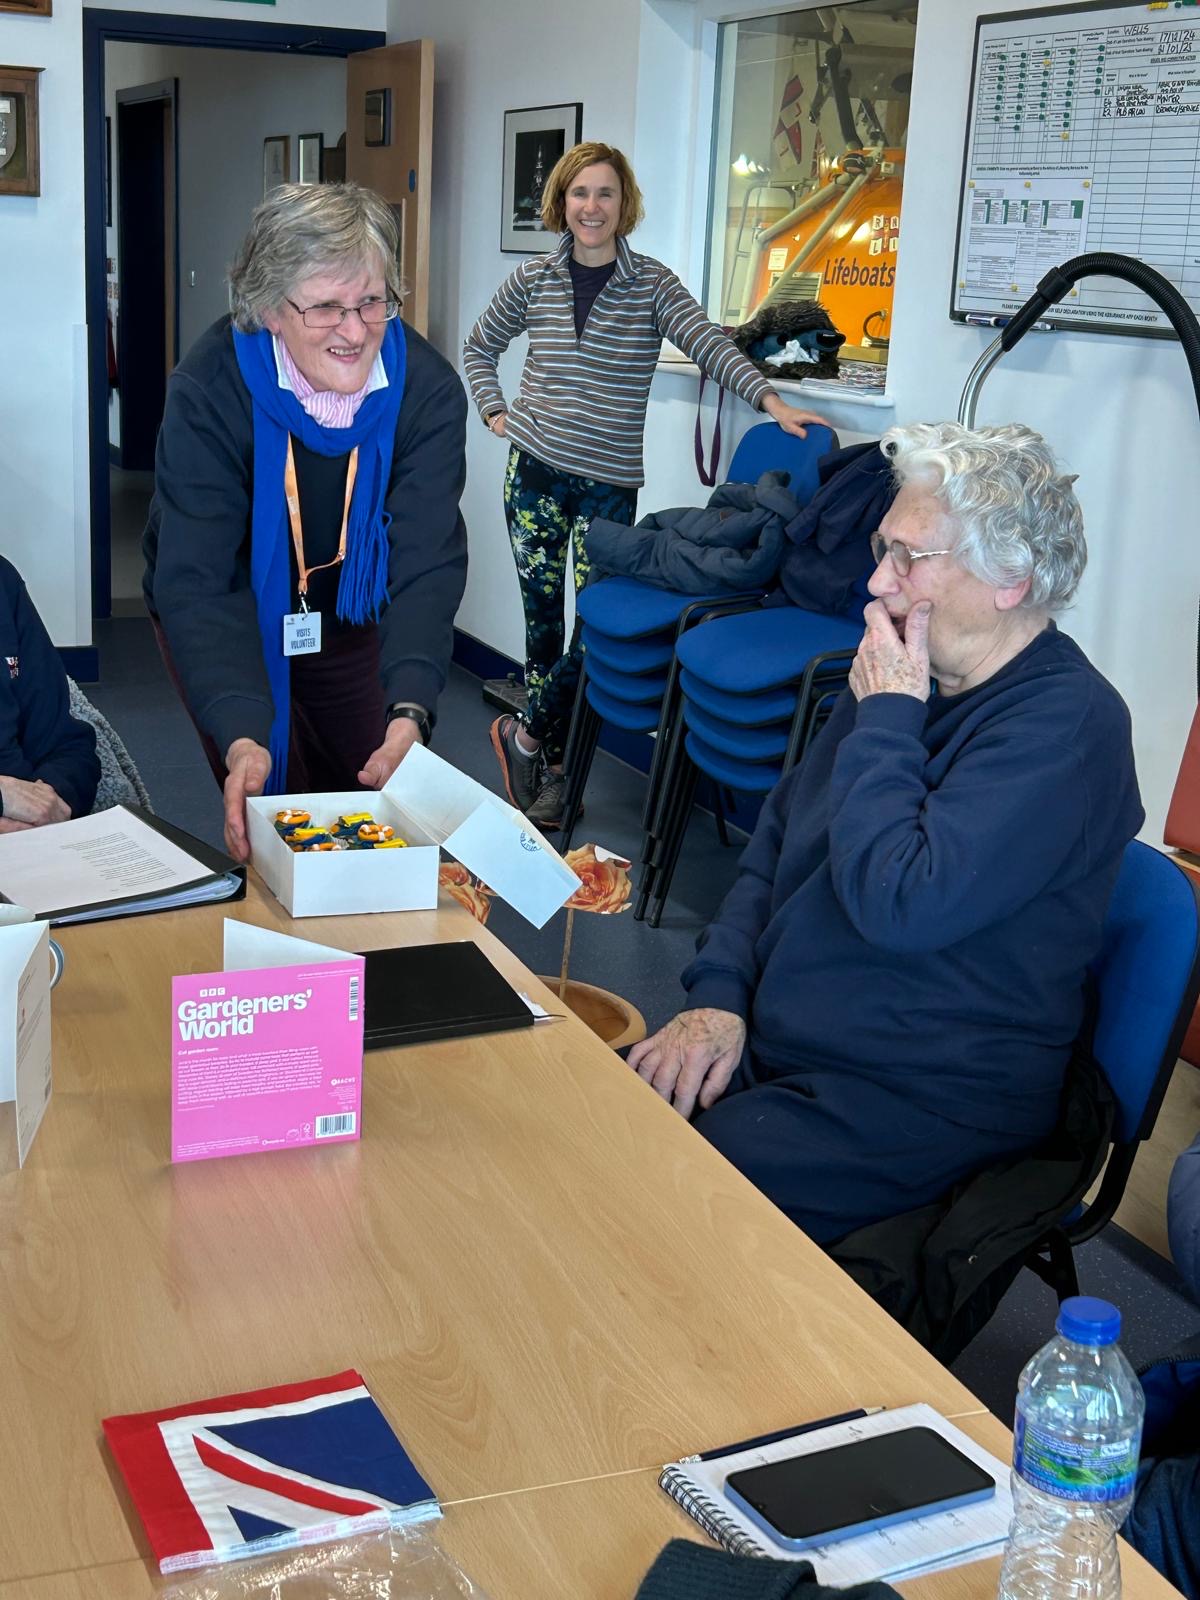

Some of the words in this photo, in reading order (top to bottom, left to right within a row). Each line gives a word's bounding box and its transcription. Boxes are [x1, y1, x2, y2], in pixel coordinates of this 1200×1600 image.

[1124, 24, 1149, 36] WELLS
[823, 257, 896, 287] Lifeboats
[296, 628, 311, 637] VISITS
[291, 637, 315, 650] VOLUNTEER
[178, 1015, 254, 1041] World
